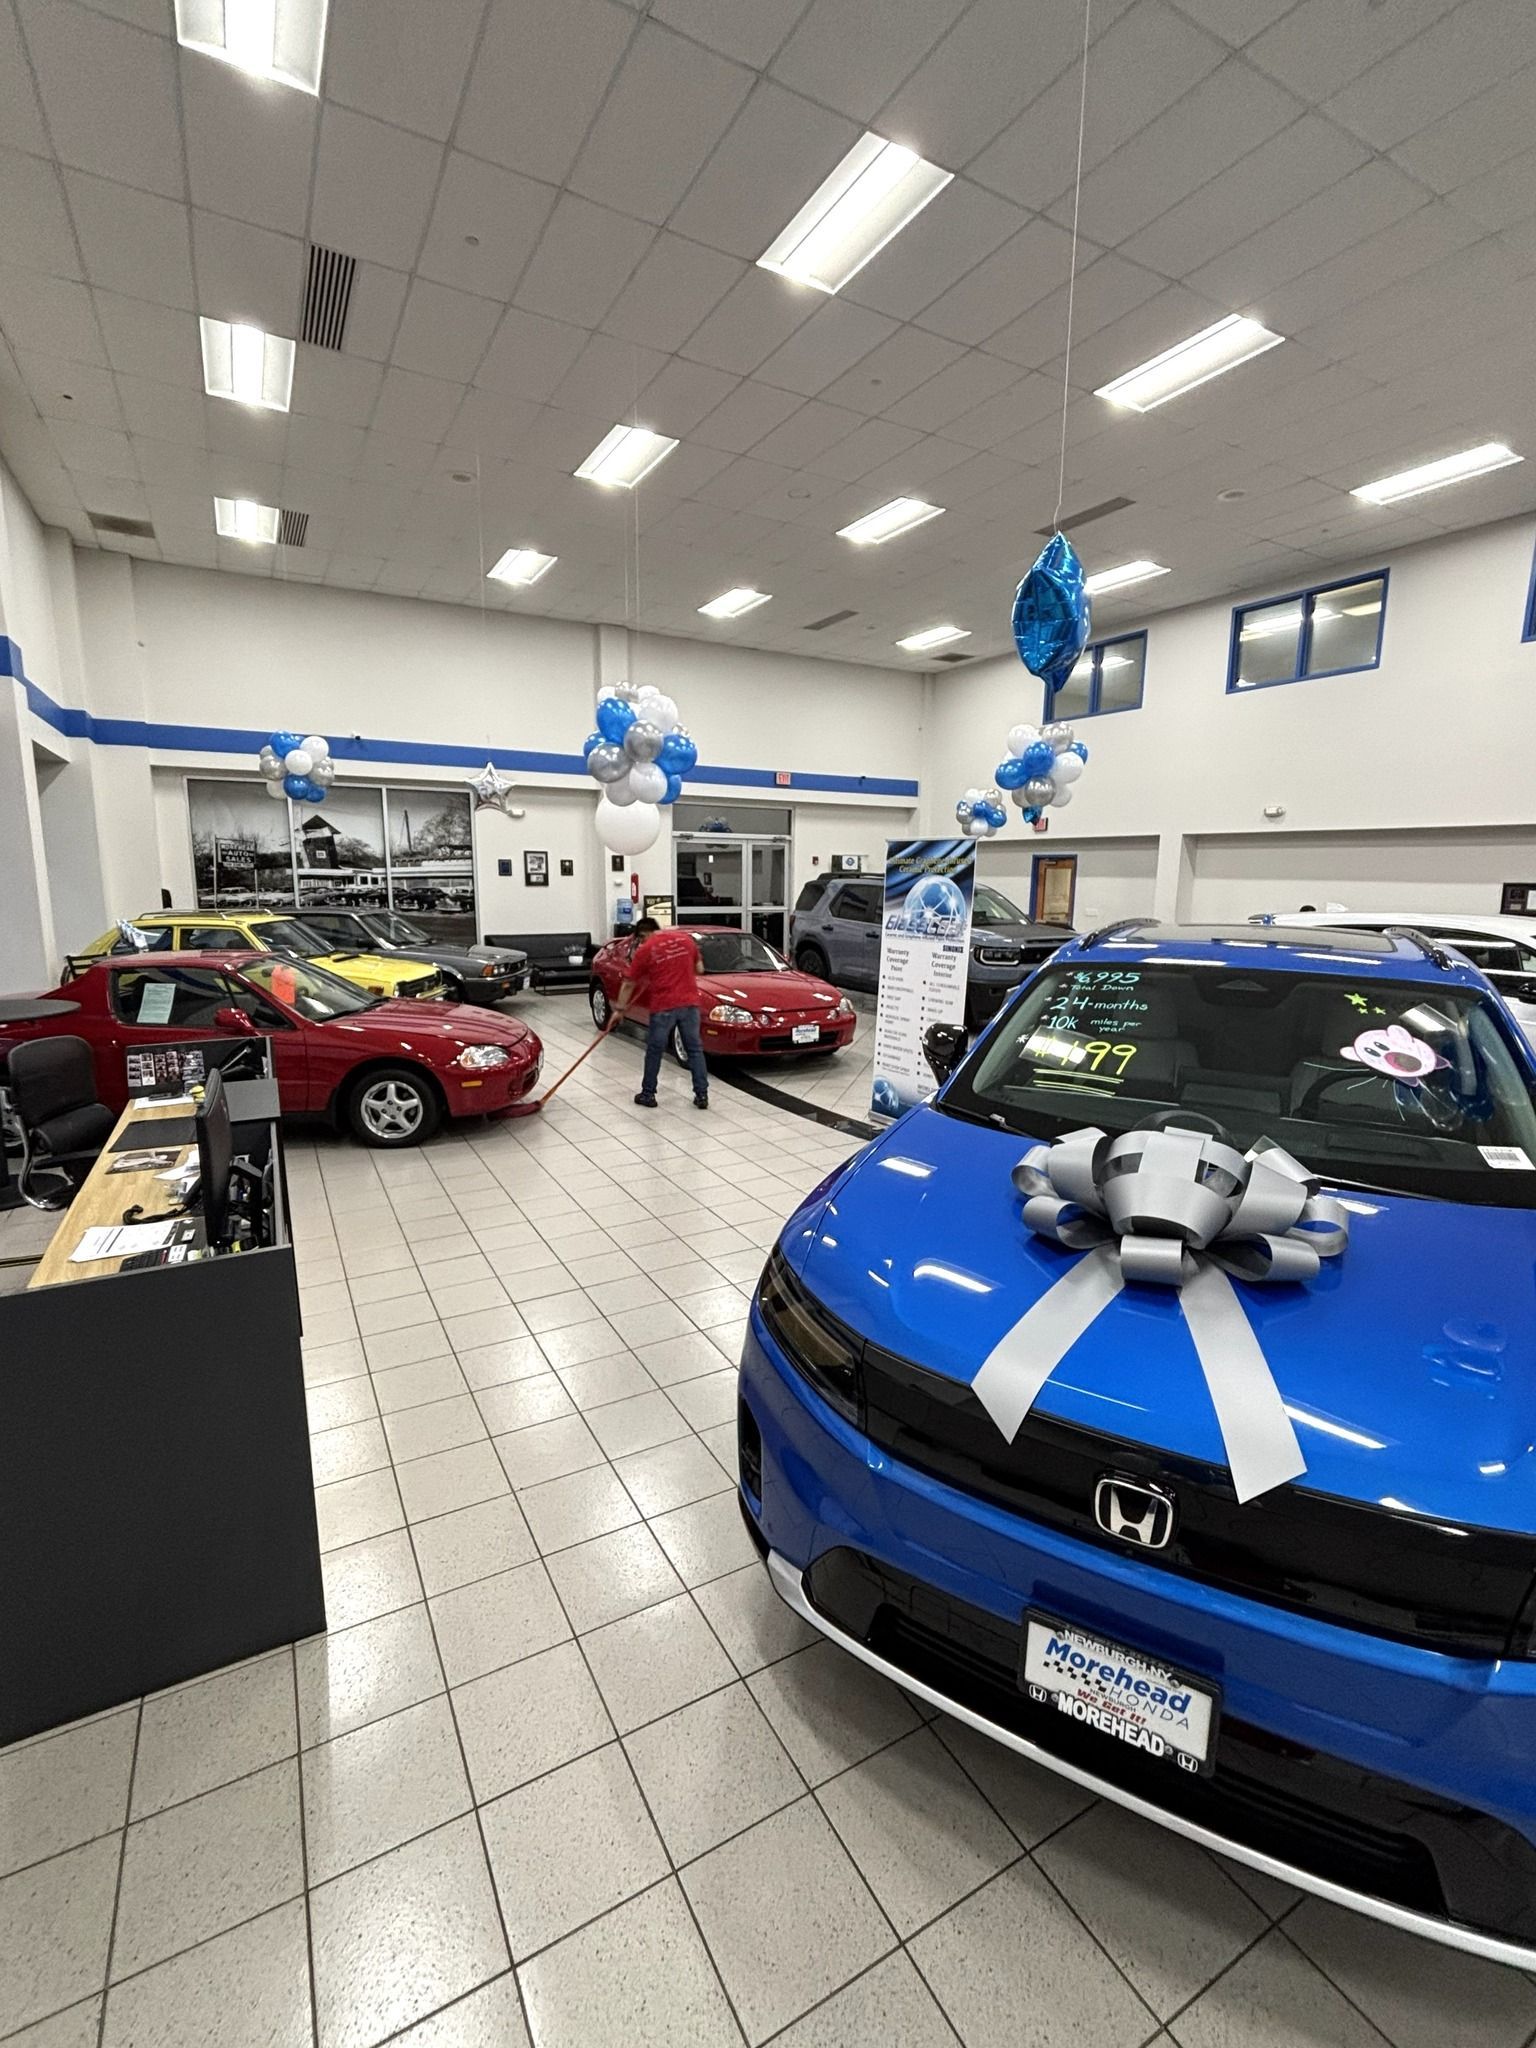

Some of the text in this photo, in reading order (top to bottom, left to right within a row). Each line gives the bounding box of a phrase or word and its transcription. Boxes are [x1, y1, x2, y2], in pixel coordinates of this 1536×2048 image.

[886, 956, 909, 965] Coverage
[887, 948, 909, 957] Warranty
[932, 952, 956, 962] Warranty
[931, 961, 956, 971] Coverage
[1090, 1018, 1119, 1026] miles
[1123, 1020, 1142, 1029] per
[1045, 1636, 1192, 1714] Morehead
[1077, 1688, 1098, 1705] We
[1102, 1700, 1125, 1717] Get
[1090, 1688, 1137, 1713] NEWBURGH
[1109, 1686, 1189, 1730] HONDA
[1057, 1690, 1166, 1758] MOREHEAD
